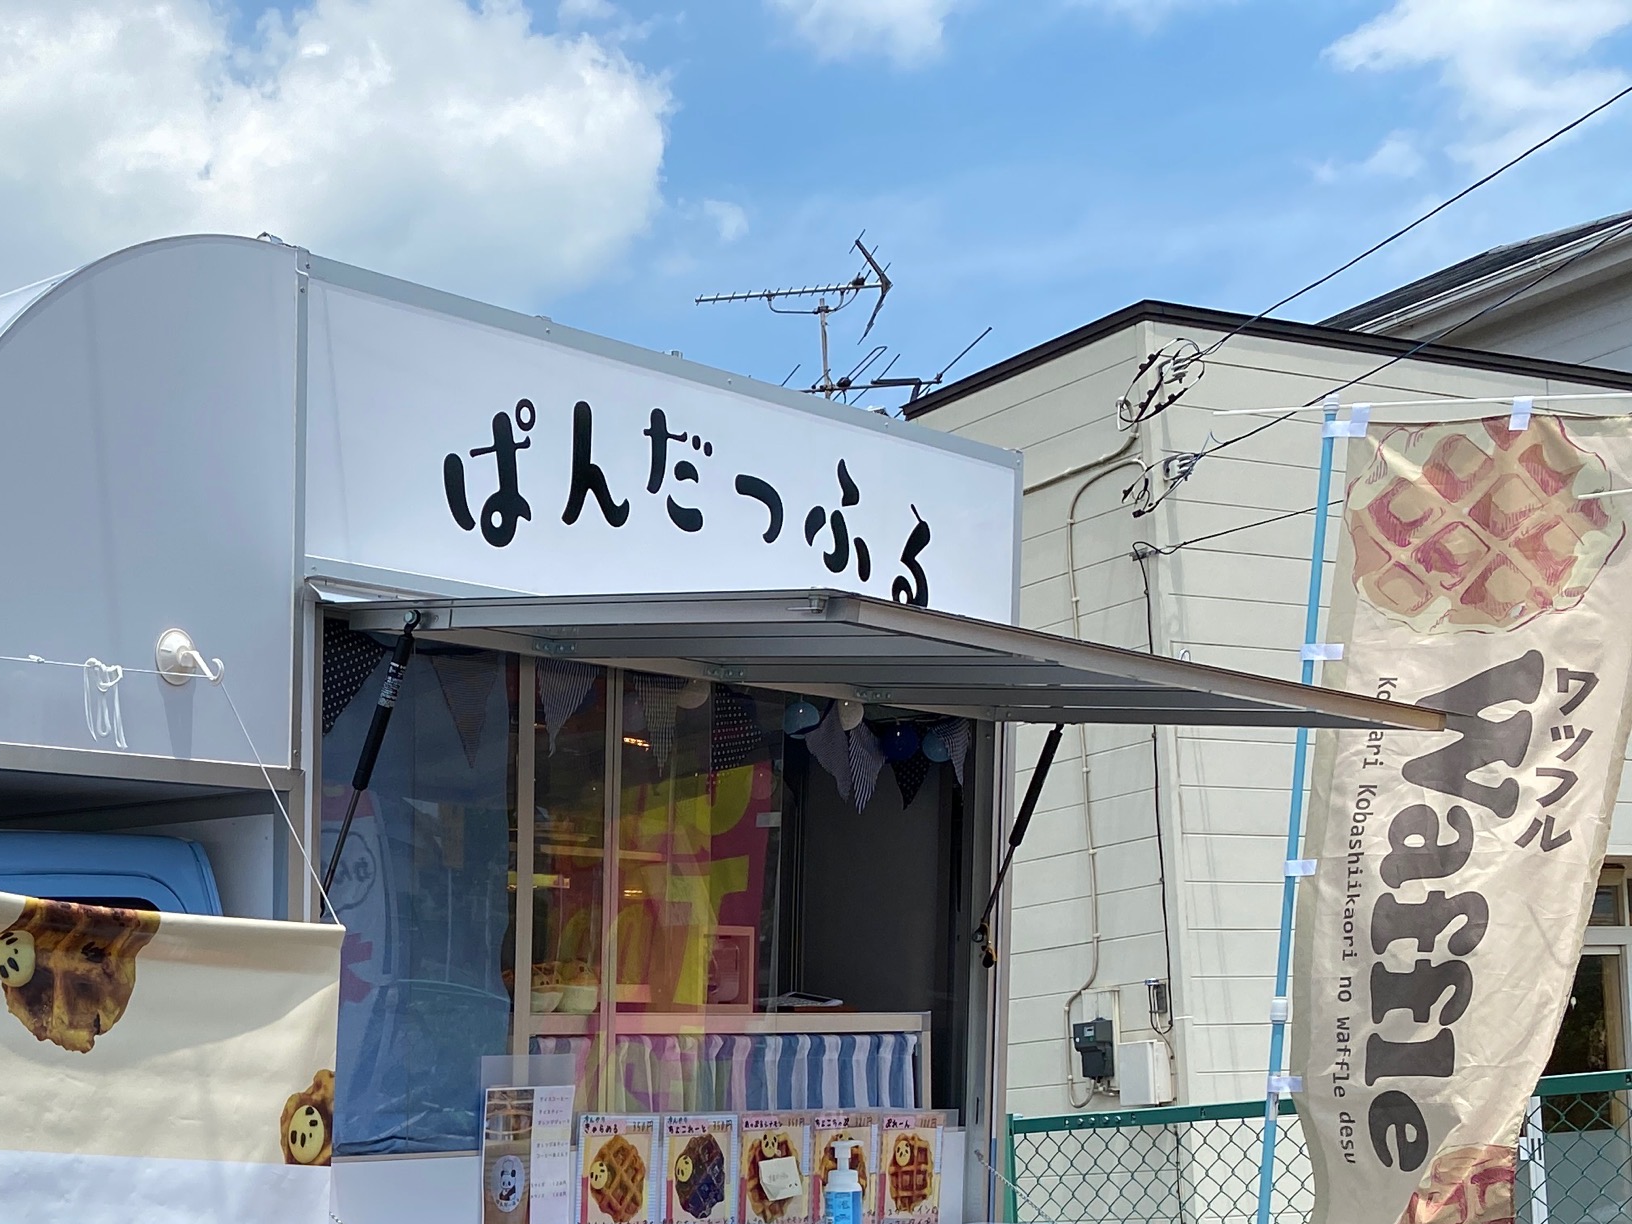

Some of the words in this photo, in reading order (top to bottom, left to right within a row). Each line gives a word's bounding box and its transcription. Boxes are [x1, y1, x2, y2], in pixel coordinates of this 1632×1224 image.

[1363, 677, 1398, 769] Koari
[1514, 665, 1601, 853] ワッフル
[1342, 784, 1378, 961] Kobashiikaori
[1365, 649, 1545, 1172] Waffle
[1337, 976, 1352, 1003] no
[1332, 1016, 1353, 1098] waffle
[1338, 1111, 1356, 1164] desu
